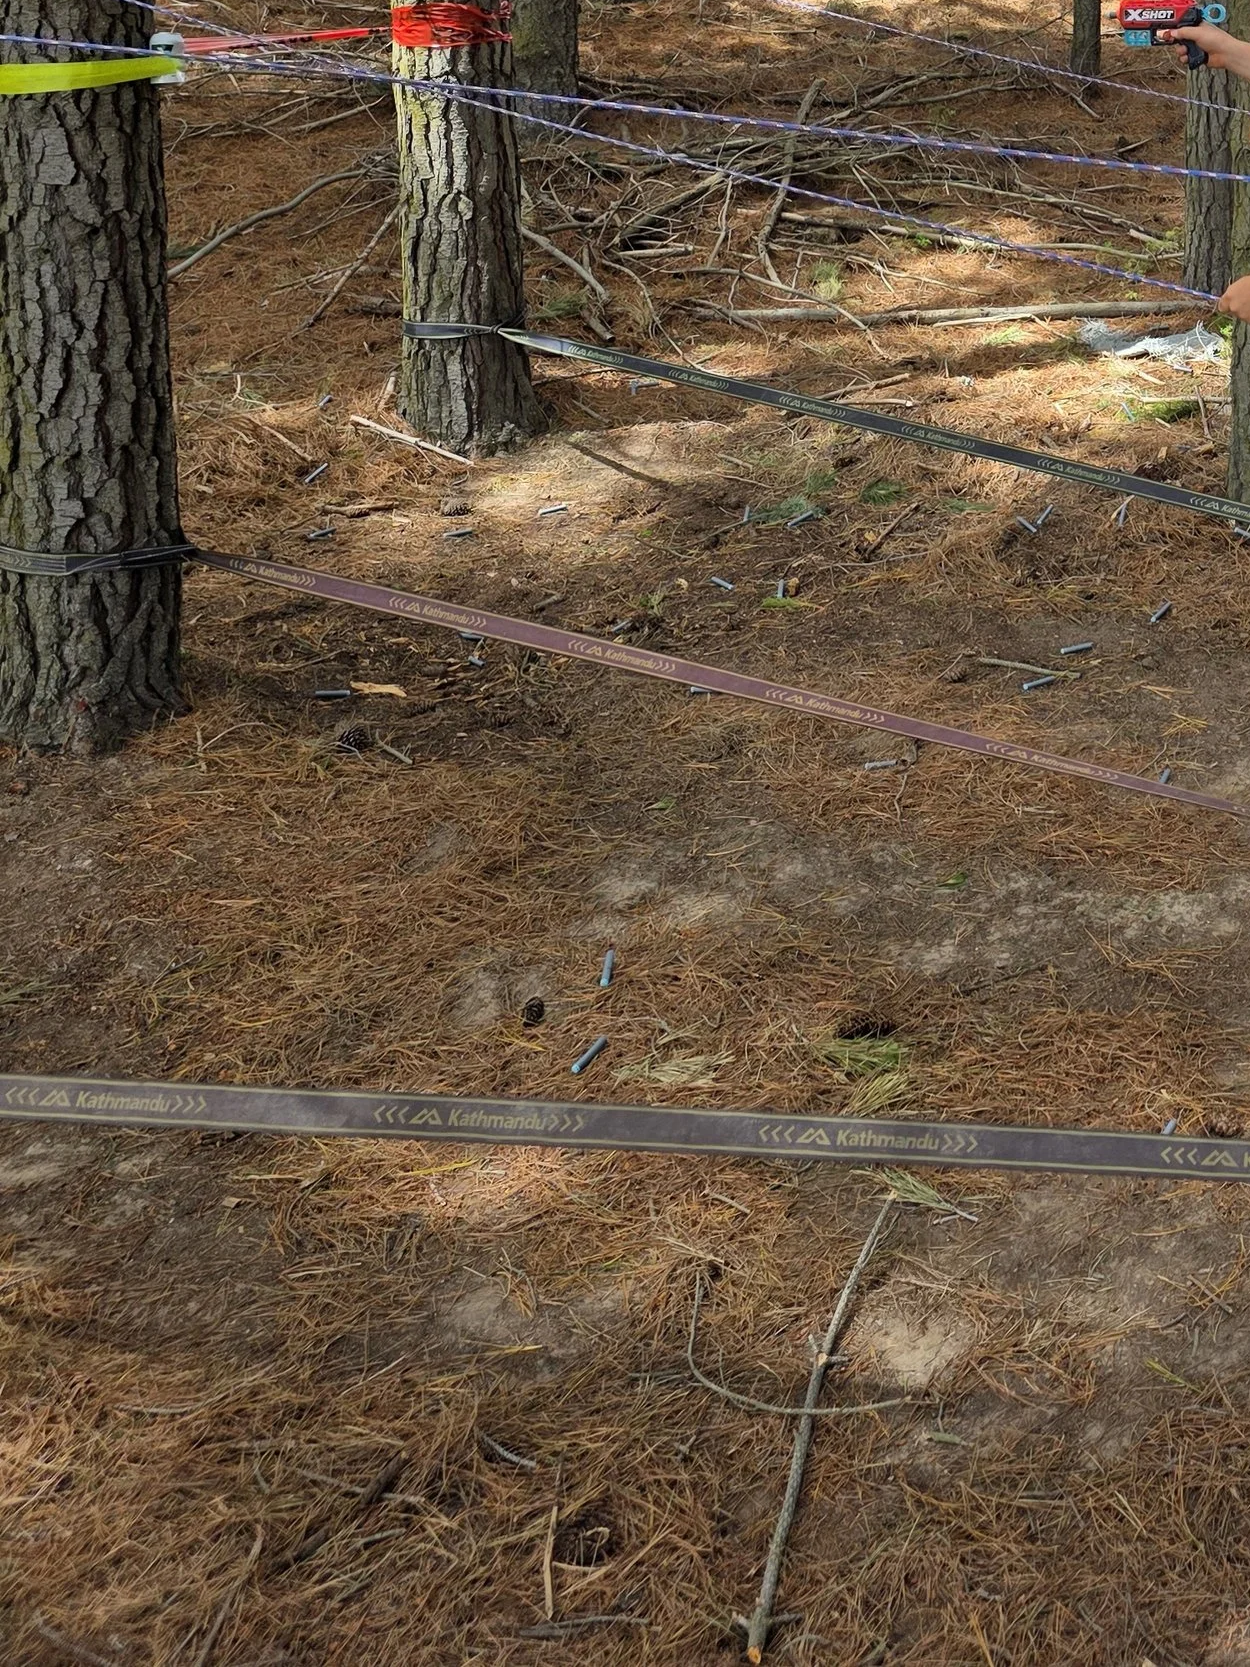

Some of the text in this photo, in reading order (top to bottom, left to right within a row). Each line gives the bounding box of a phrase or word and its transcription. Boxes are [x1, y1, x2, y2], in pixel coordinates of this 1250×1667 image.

[1064, 465, 1105, 482] Kathmandu
[422, 604, 469, 625] Kathmandu
[604, 648, 656, 669] Kathmandu
[805, 697, 862, 719] Kathmandu
[75, 1090, 171, 1113] Kathmandu
[448, 1109, 547, 1130] Kathmandu
[836, 1130, 939, 1150] Kathmandu
